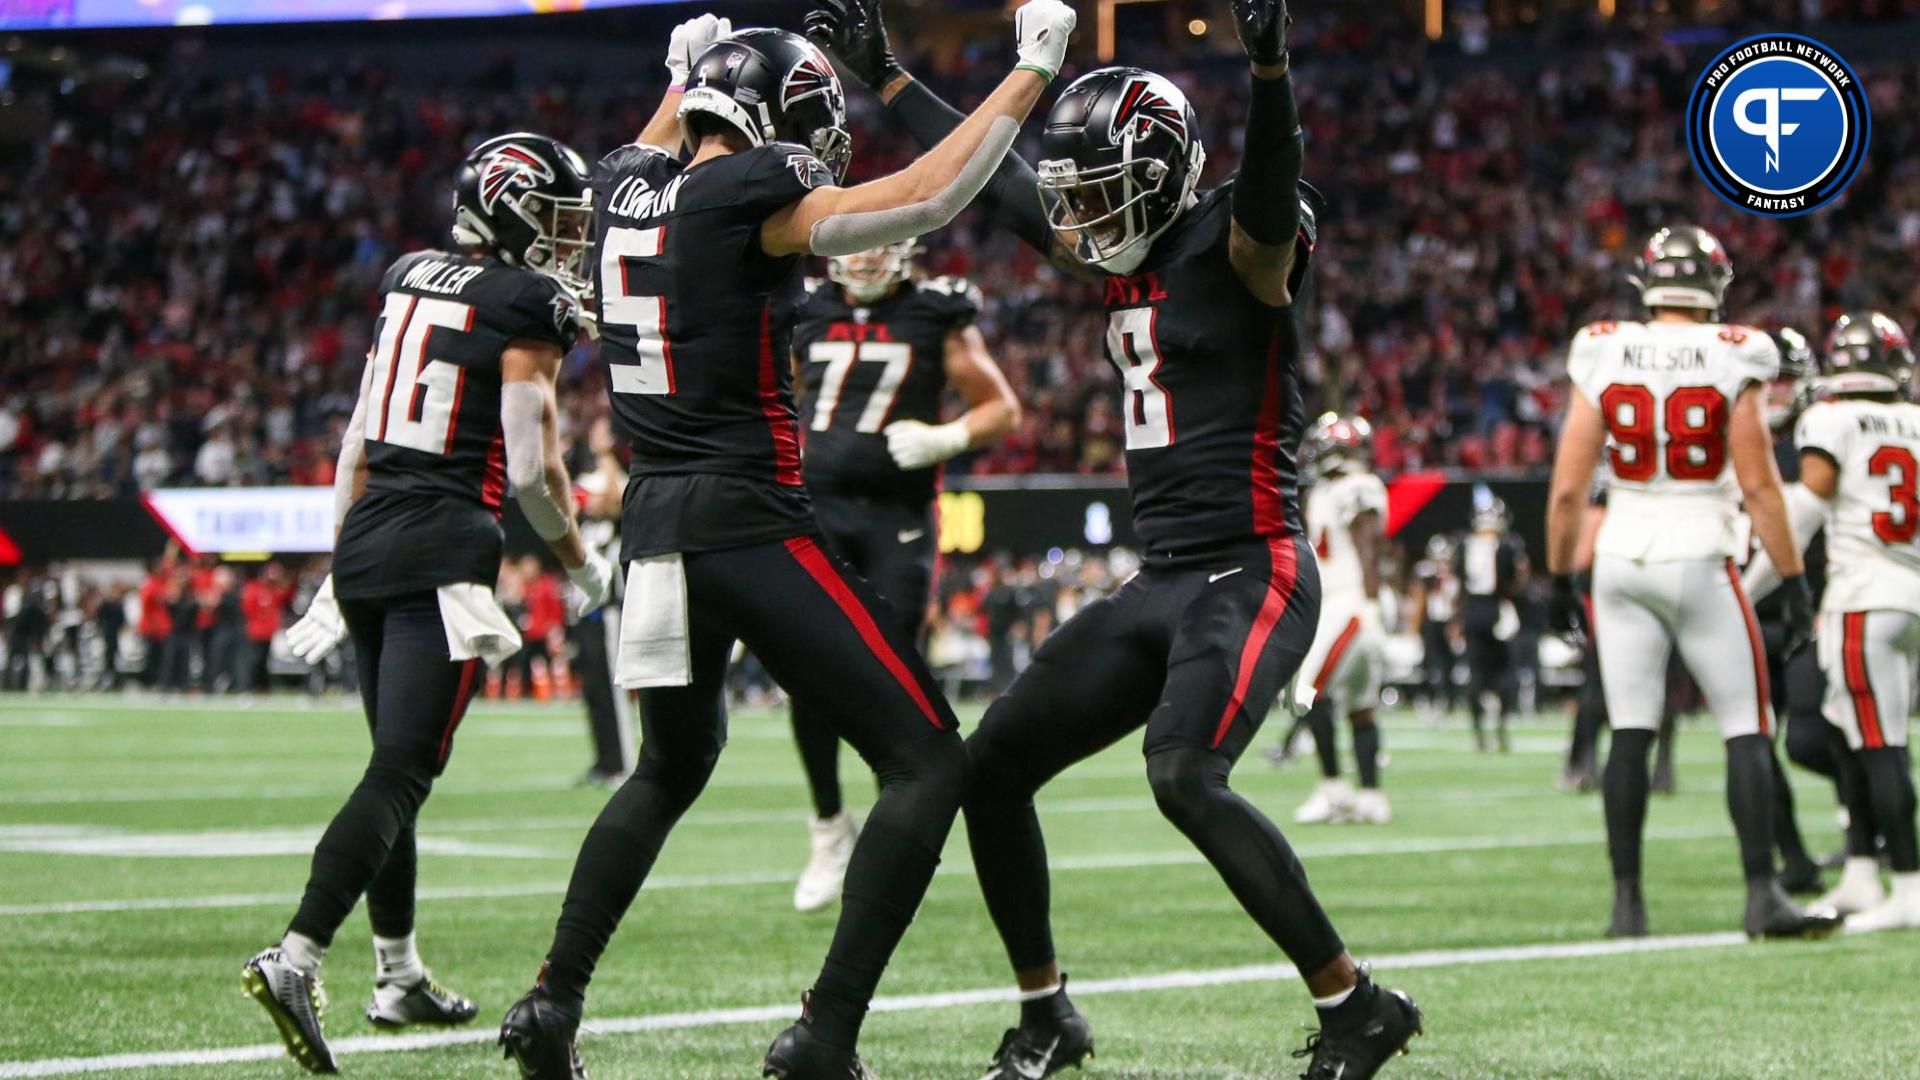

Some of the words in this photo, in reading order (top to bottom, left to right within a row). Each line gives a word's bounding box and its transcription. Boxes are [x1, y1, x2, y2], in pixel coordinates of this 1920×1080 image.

[401, 258, 485, 295] MILLER
[600, 224, 677, 395] 5
[1104, 273, 1169, 306] ATL
[364, 291, 477, 457] 16
[825, 321, 896, 342] ATL
[1106, 305, 1176, 451] 8
[1623, 344, 1709, 372] NELSON
[808, 341, 915, 434] 77
[1599, 382, 1728, 482] 98
